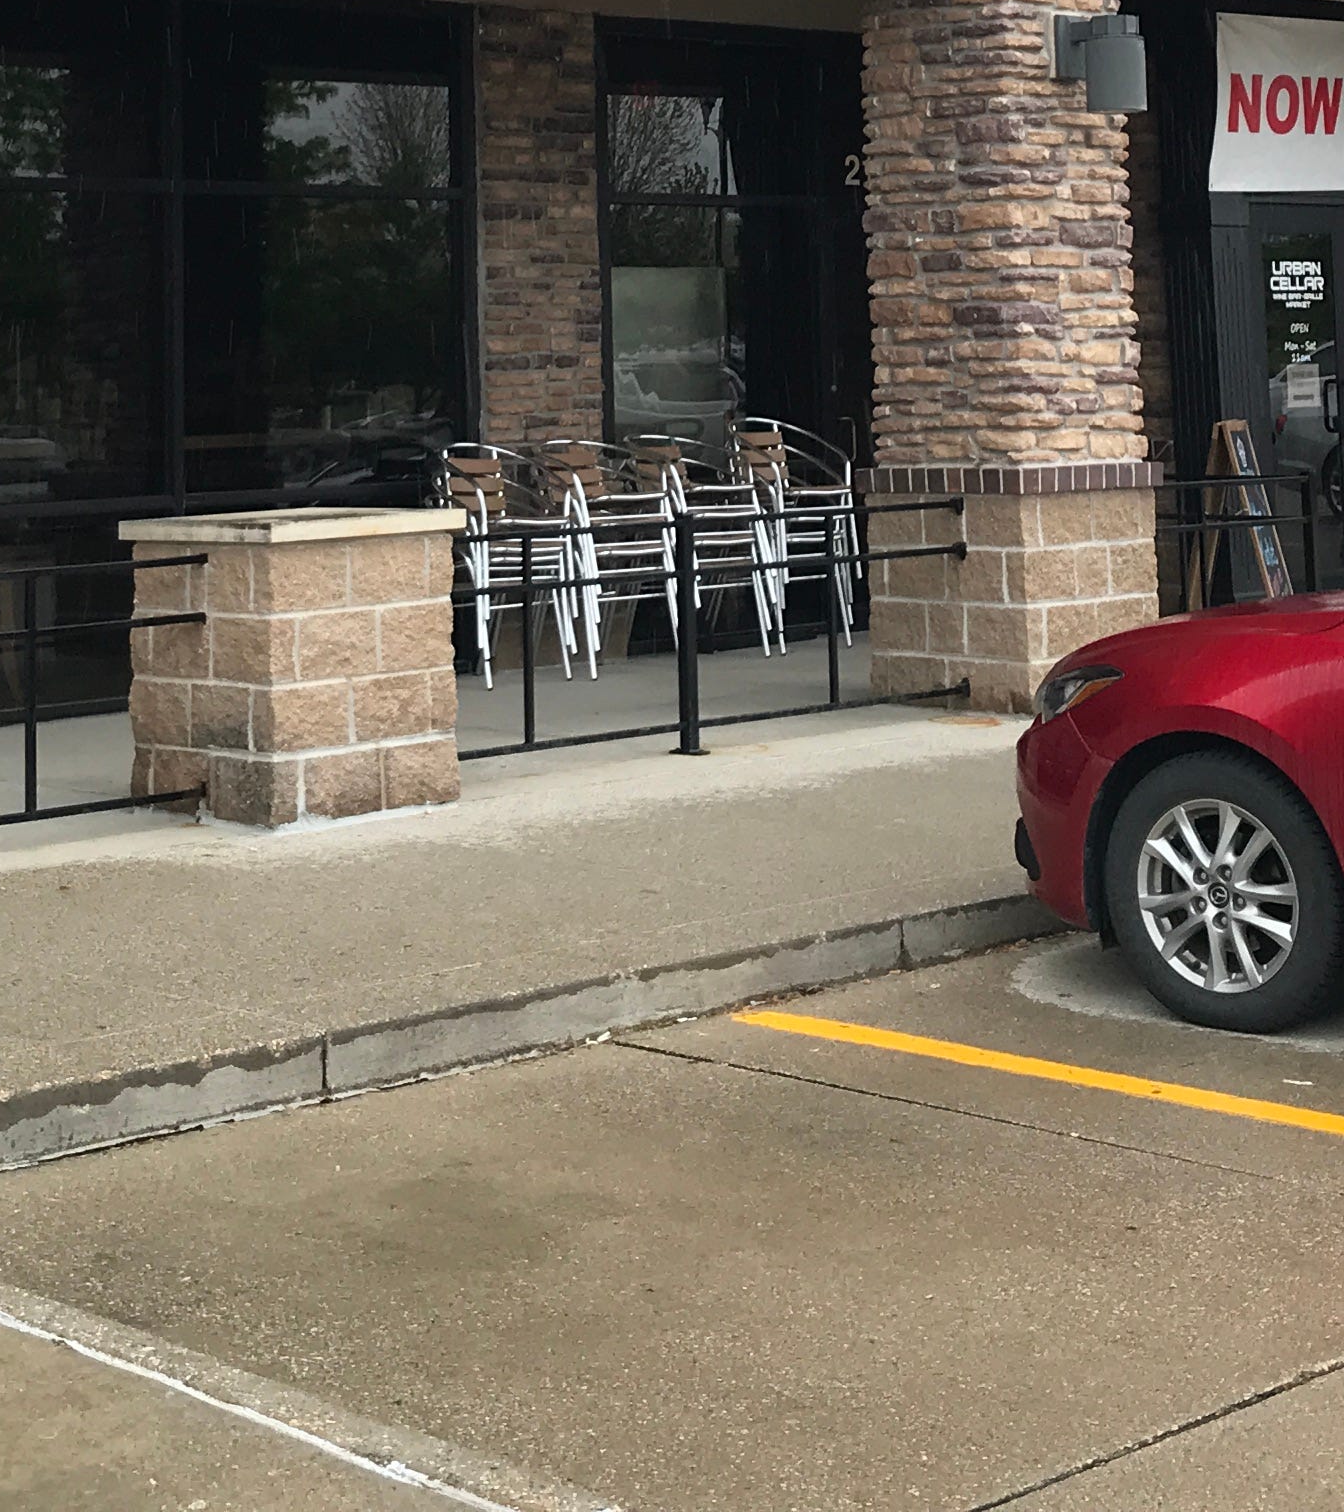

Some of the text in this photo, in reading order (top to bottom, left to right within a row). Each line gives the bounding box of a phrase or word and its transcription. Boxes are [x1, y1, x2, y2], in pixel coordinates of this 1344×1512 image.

[1227, 73, 1344, 136] NOW
[1271, 261, 1322, 276] URBAN
[1269, 276, 1325, 291] CELLAR
[1290, 322, 1310, 334] OPEN
